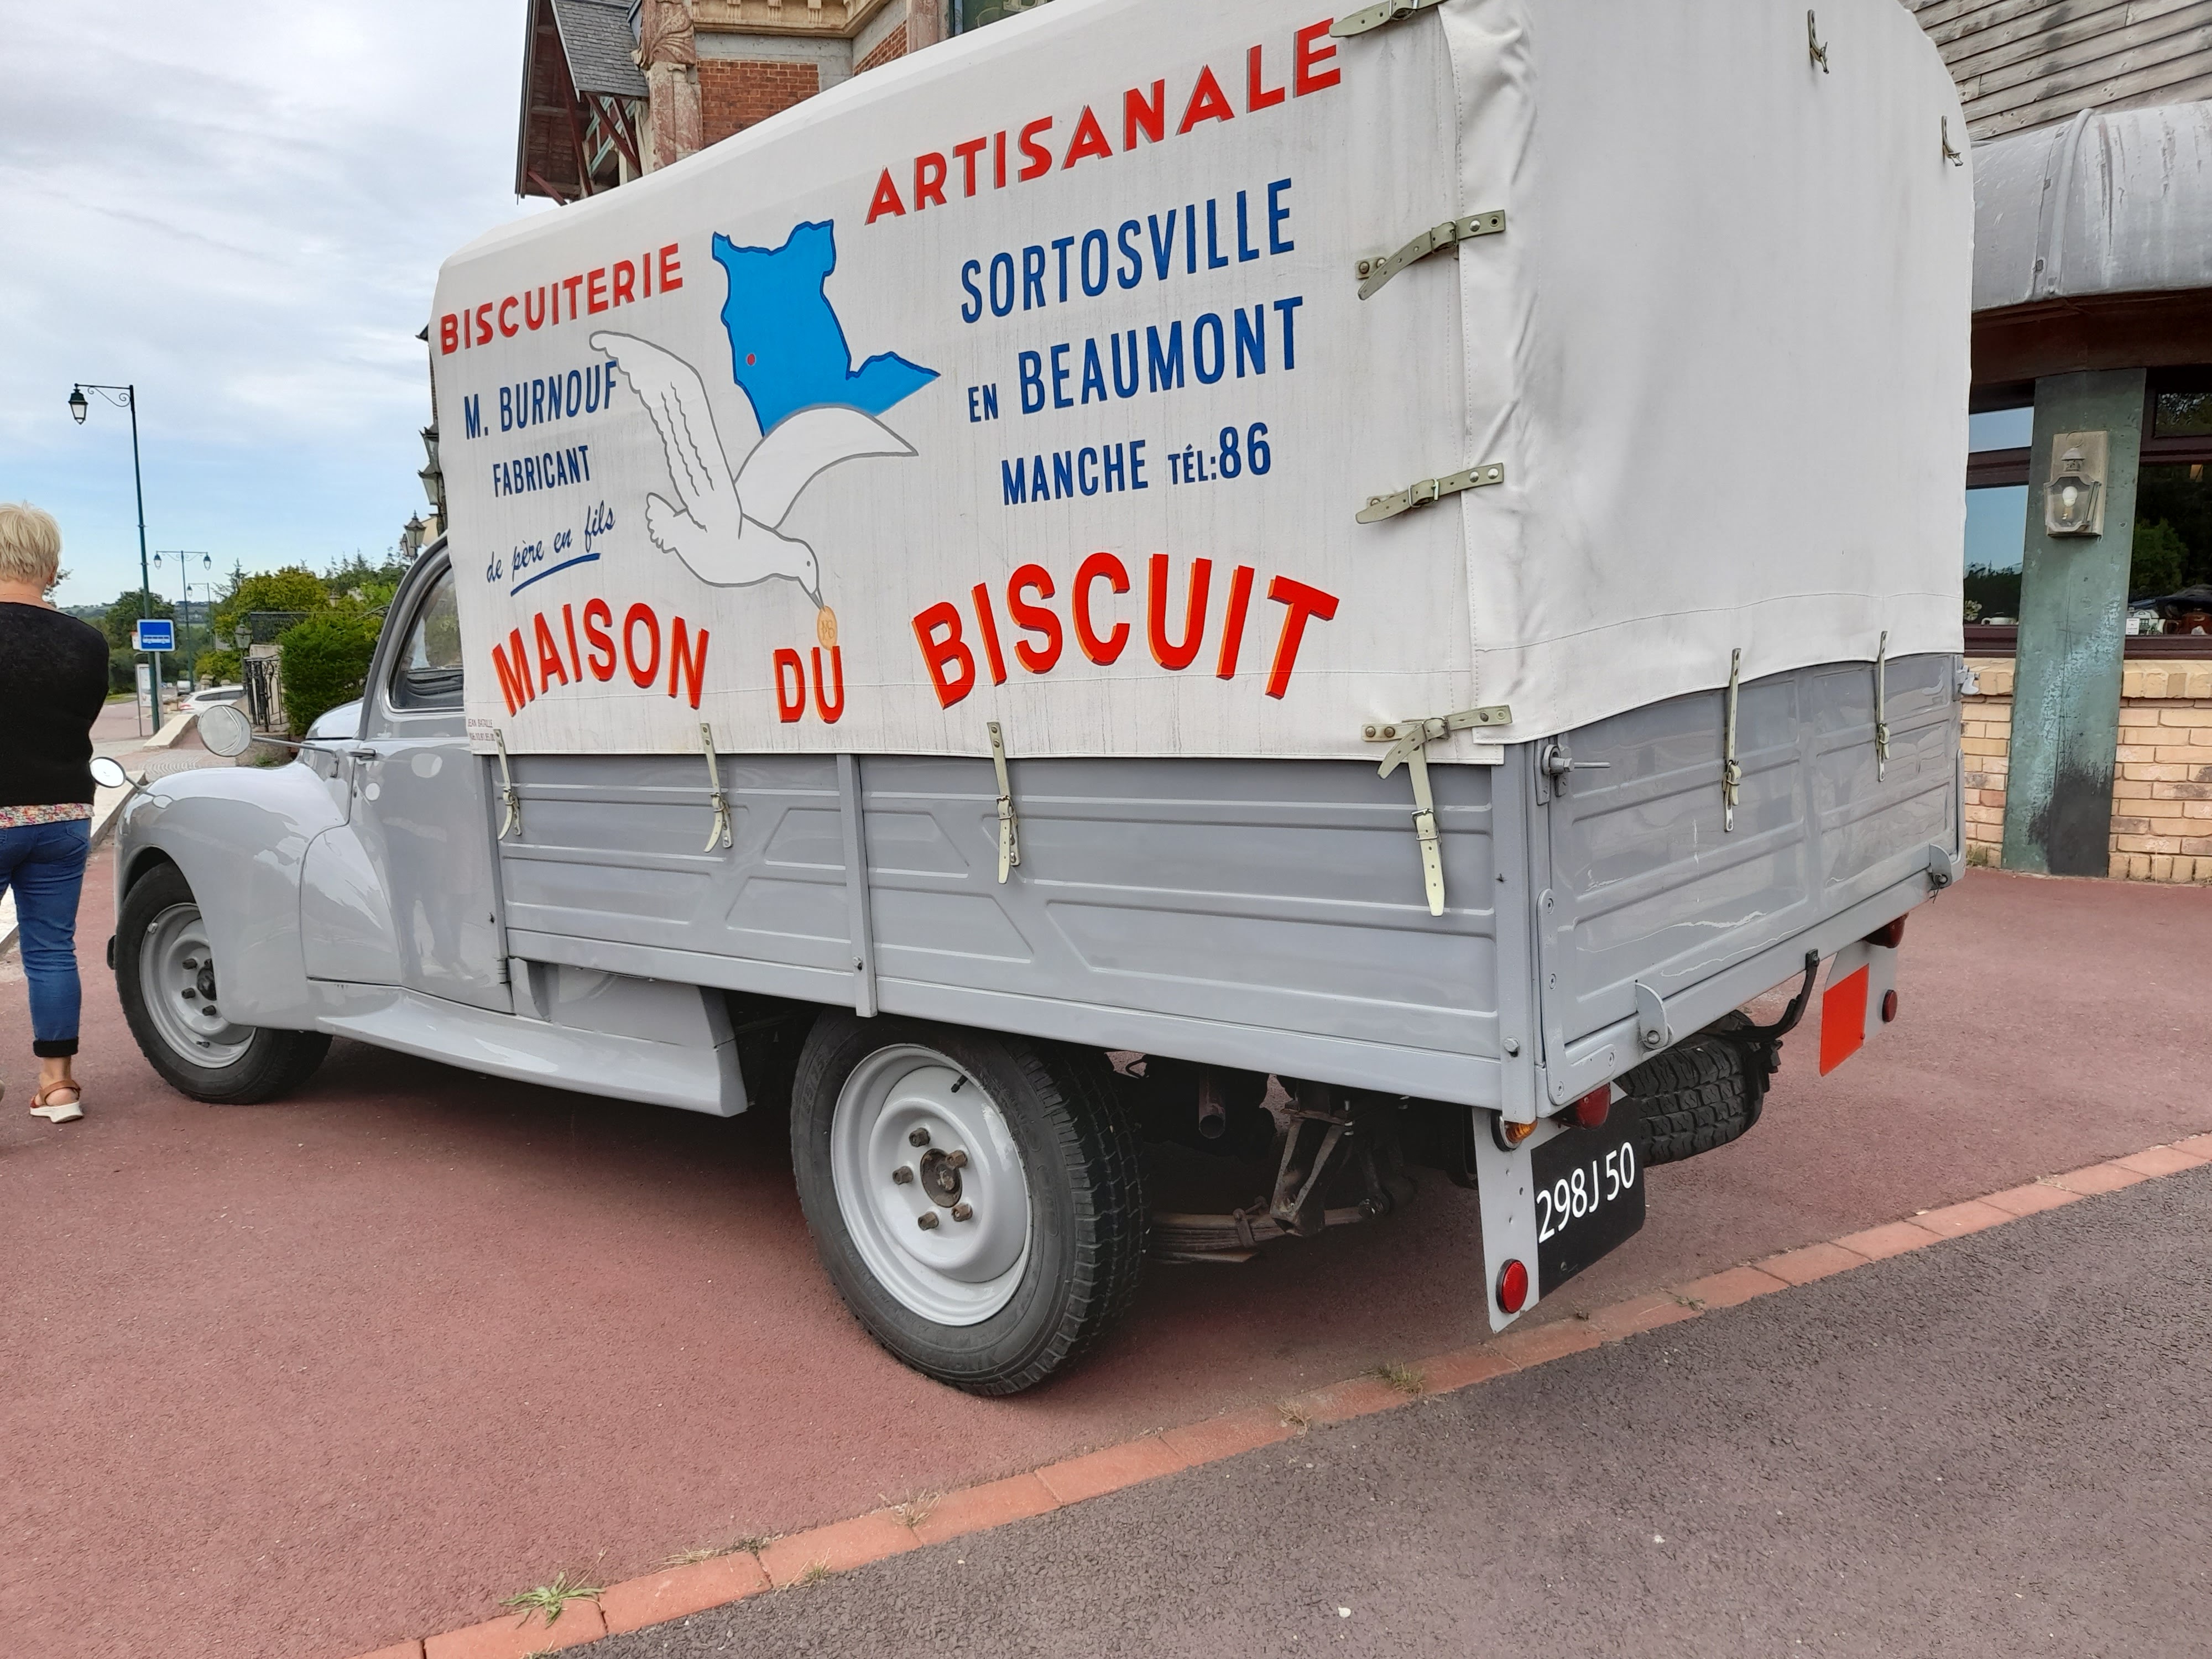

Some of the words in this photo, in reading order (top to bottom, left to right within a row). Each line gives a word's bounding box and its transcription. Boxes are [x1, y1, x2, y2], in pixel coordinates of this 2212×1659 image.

[864, 18, 1342, 226] ARTISANALE
[440, 243, 683, 356] BISCUITERIE
[961, 178, 1295, 324] SORTOSVILLE
[464, 394, 488, 440] M.
[499, 359, 617, 432] BURNOUF
[968, 383, 999, 422] EN
[1019, 296, 1304, 414] BEAUMONT
[493, 445, 590, 498] FABRICANT
[1001, 440, 1149, 505] MANCHE
[487, 551, 503, 583] de
[512, 540, 545, 582] père
[554, 528, 572, 552] en
[584, 500, 616, 551] fils
[492, 598, 710, 717] MAISON
[774, 645, 844, 723] DU
[911, 552, 1339, 710] BISCUIT
